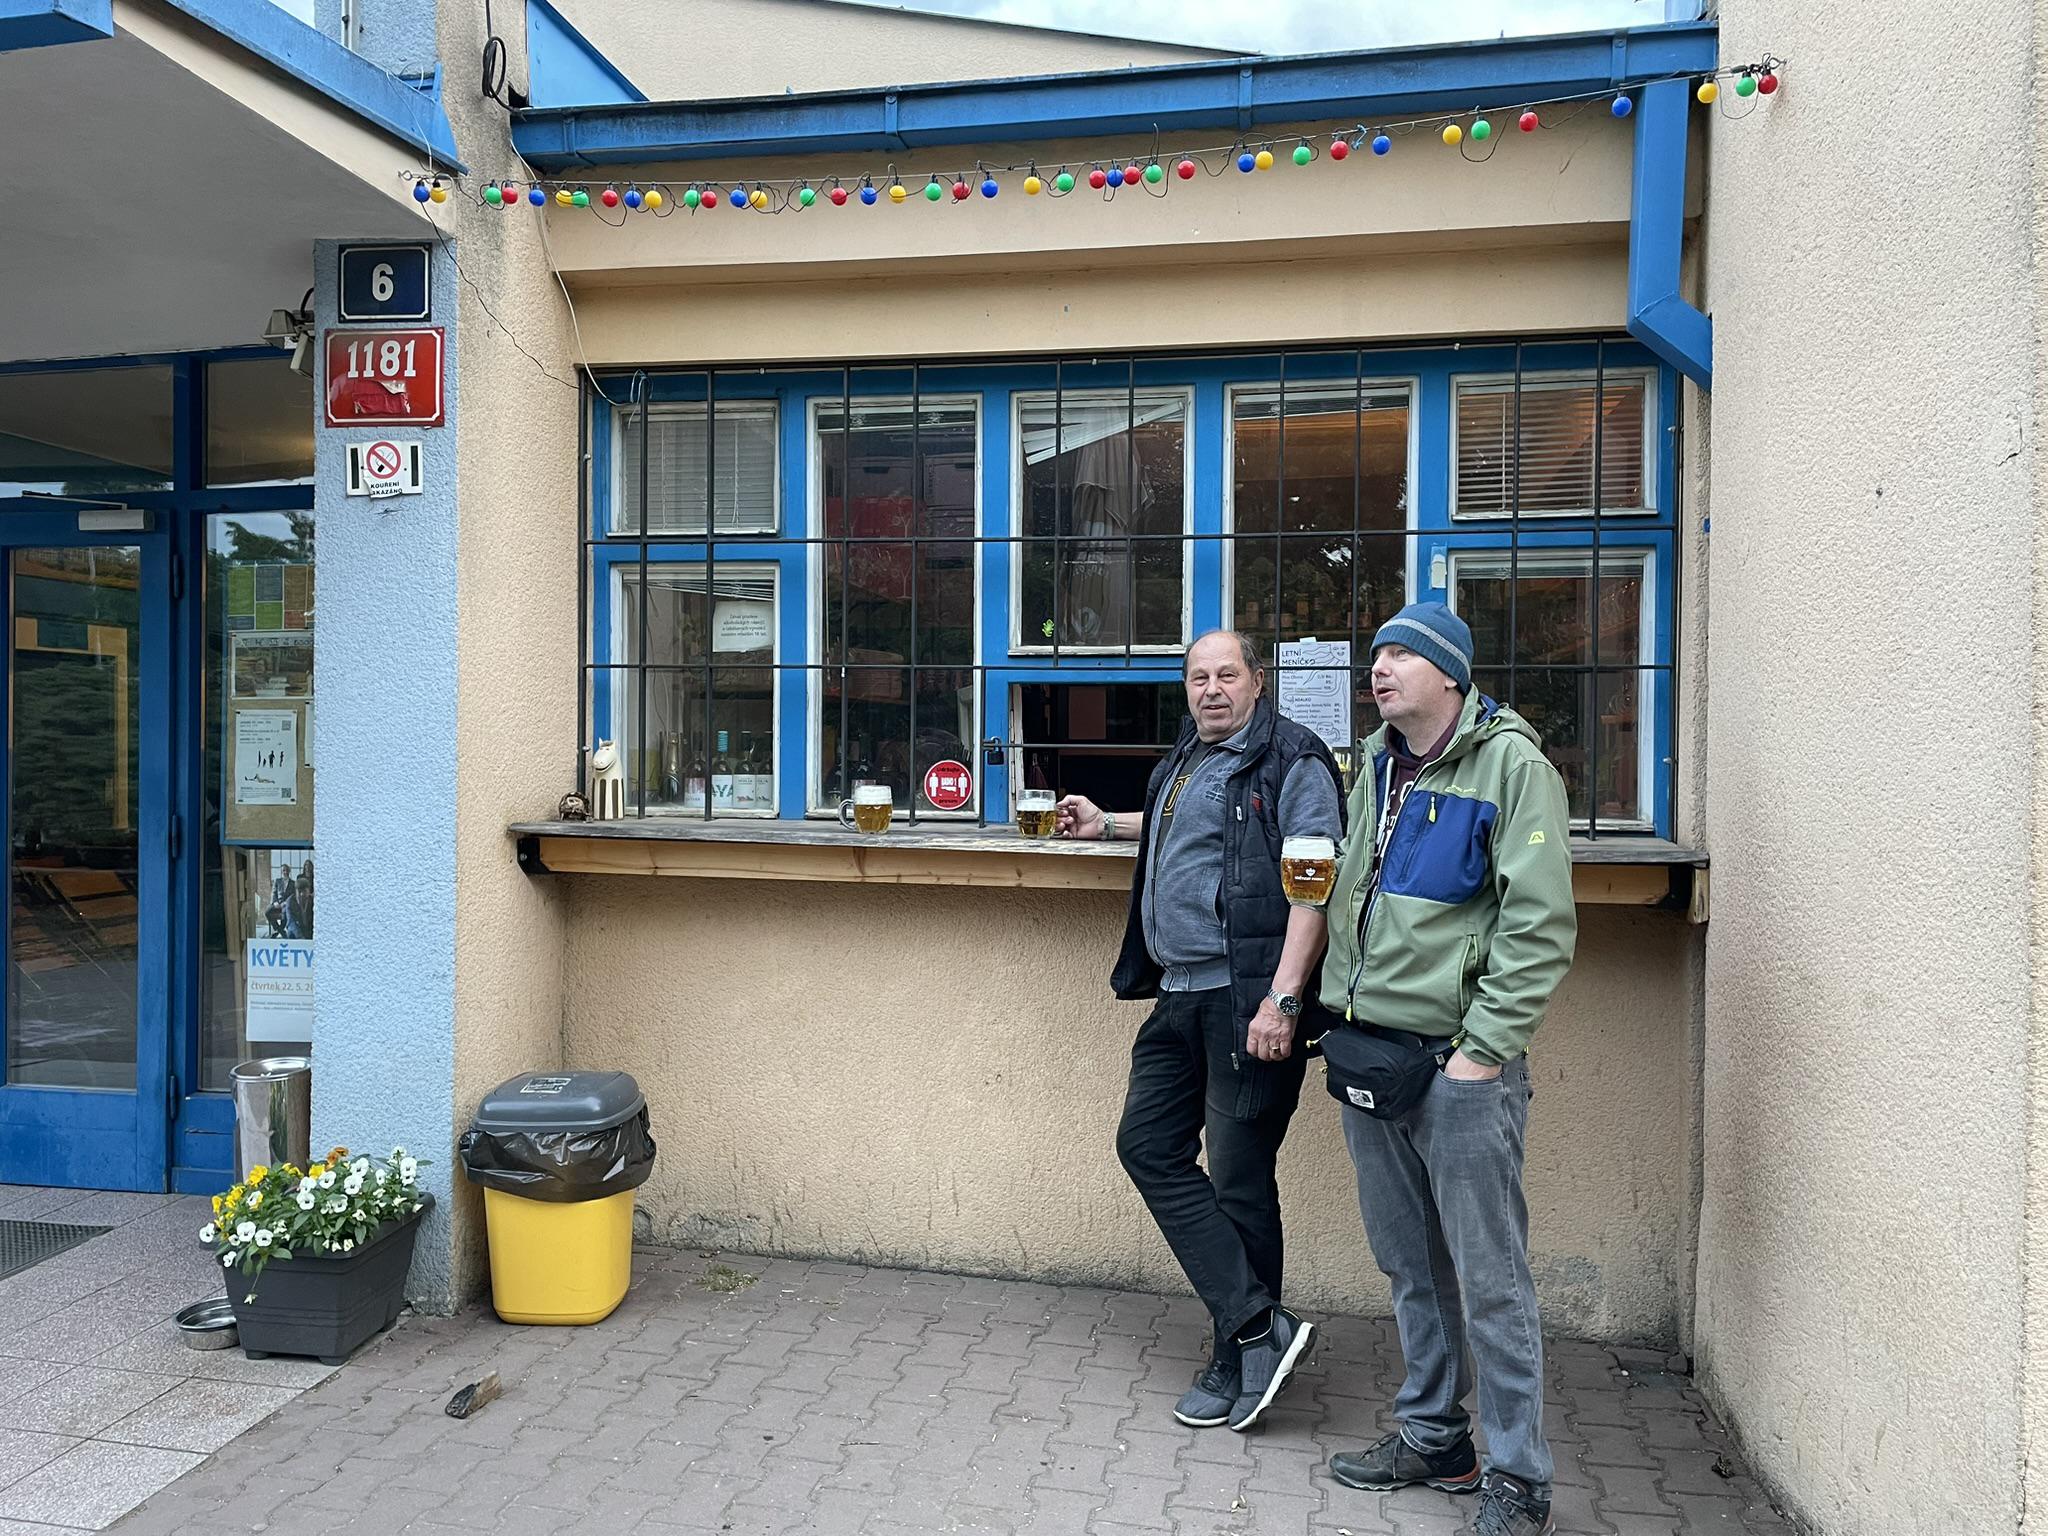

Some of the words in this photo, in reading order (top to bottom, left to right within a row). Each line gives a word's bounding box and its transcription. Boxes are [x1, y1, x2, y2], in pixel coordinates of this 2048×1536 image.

[372, 263, 394, 302] 6
[347, 339, 417, 378] 1181
[370, 480, 400, 489] KOUŘENÍ
[1282, 649, 1302, 657] LETNÍ
[252, 943, 313, 968] KVĚTY
[251, 981, 281, 991] čtvrtek
[282, 983, 294, 991] 22.
[296, 983, 304, 991] 5.
